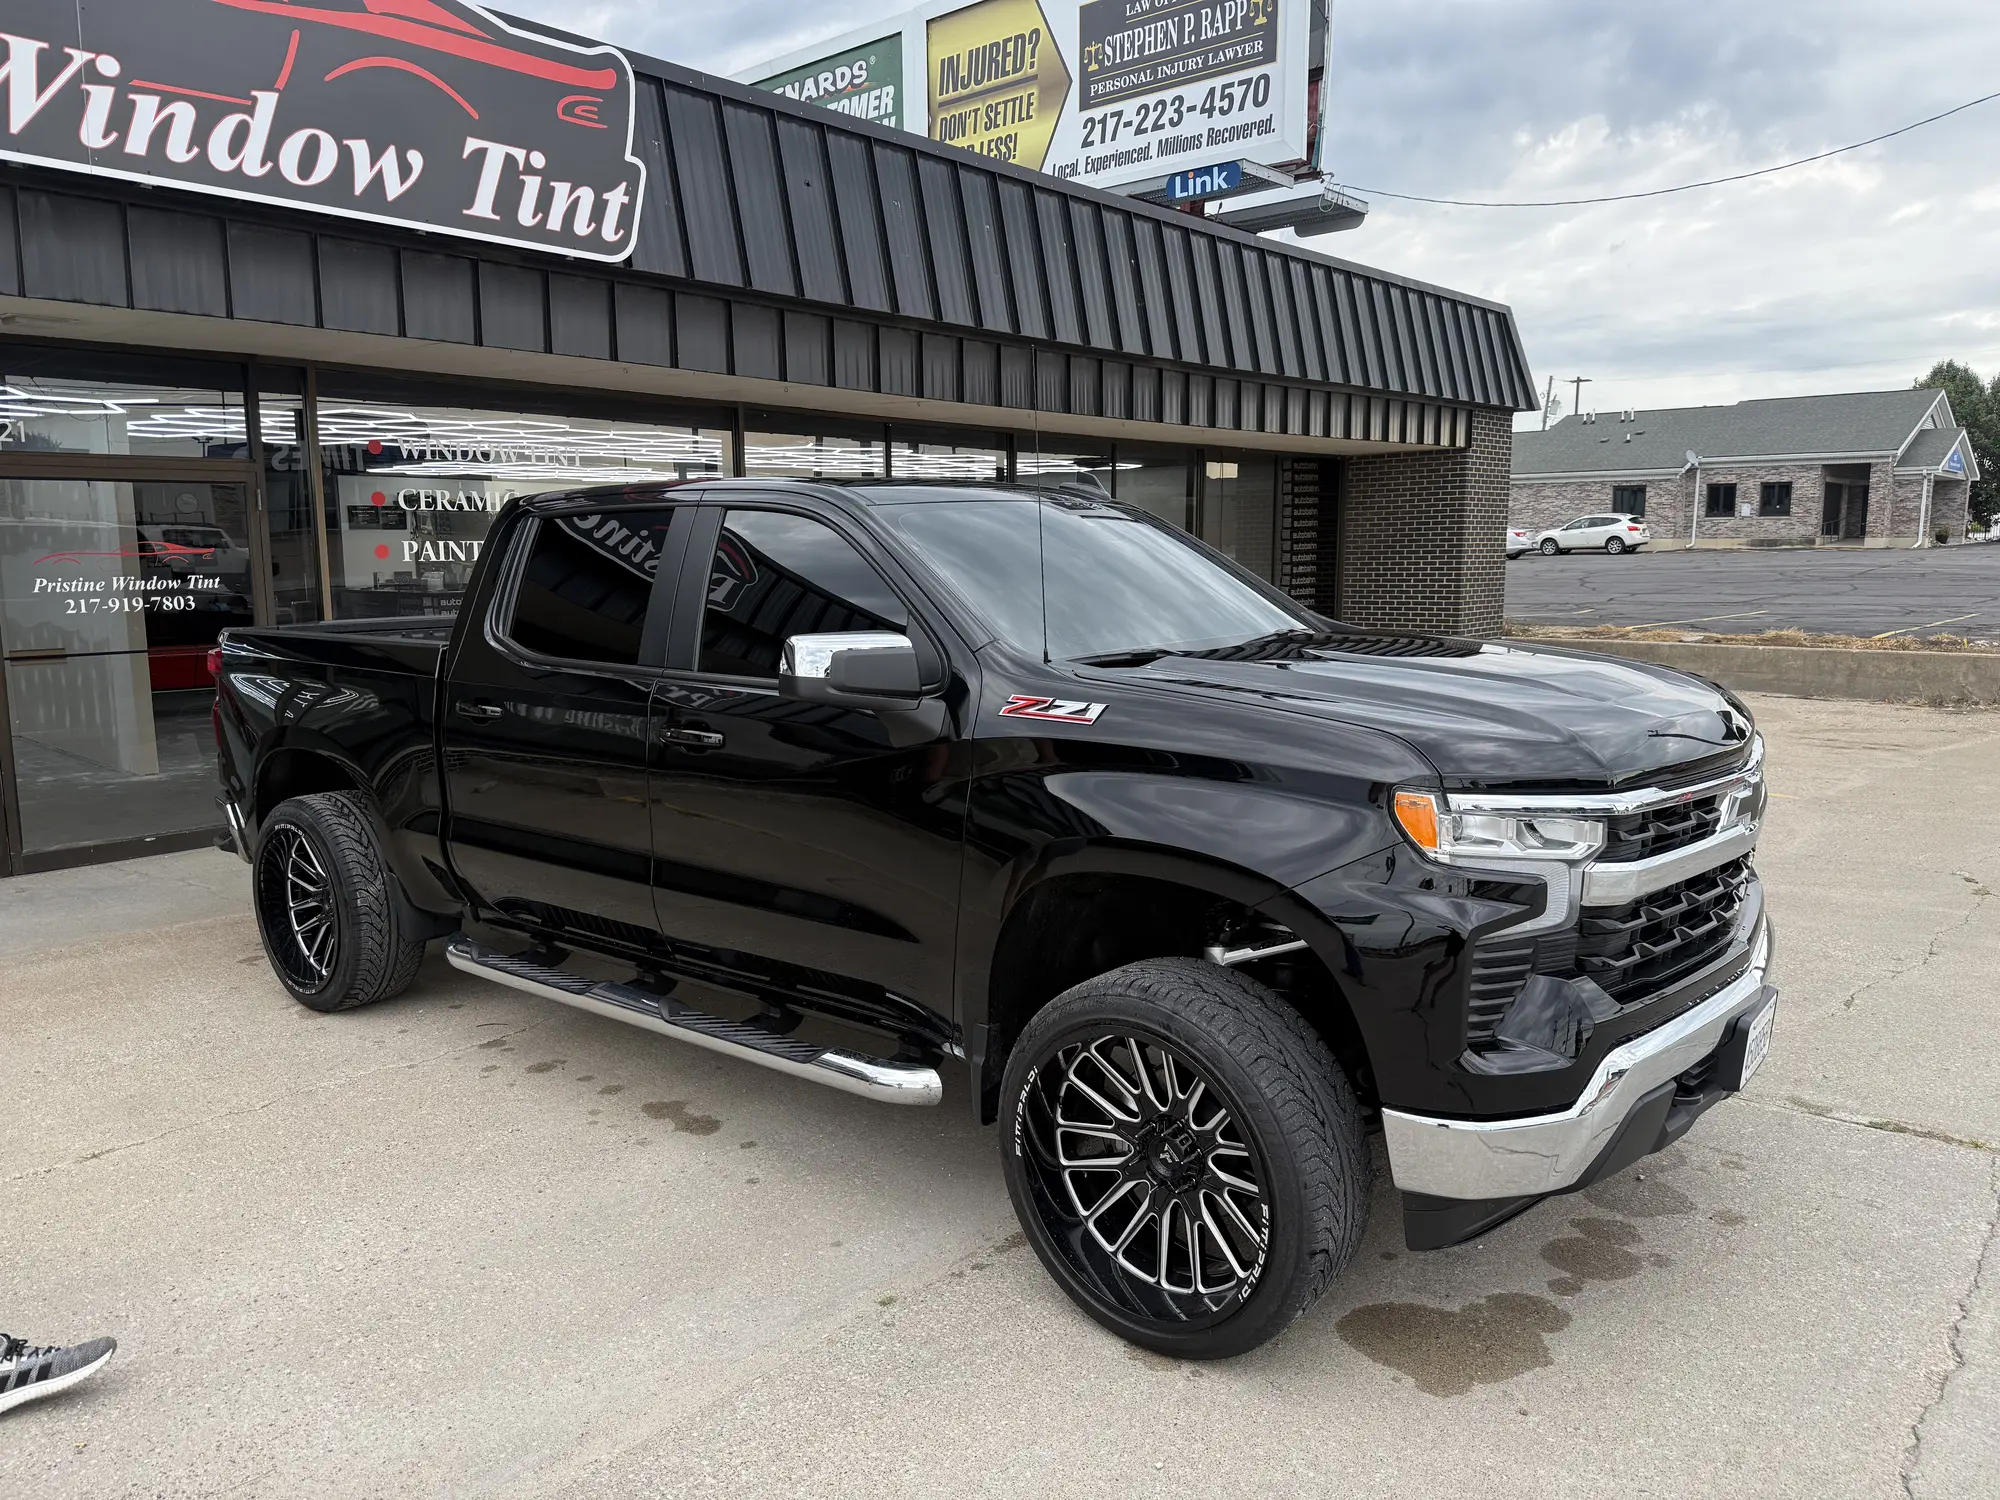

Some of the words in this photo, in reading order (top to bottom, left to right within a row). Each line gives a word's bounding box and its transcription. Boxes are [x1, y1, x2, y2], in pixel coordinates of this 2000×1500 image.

[1126, 1, 1151, 16] LAW
[1105, 16, 1179, 67] STEPHEN
[1183, 13, 1195, 45] P.
[1201, 0, 1247, 40] RAPP
[773, 60, 868, 102] NARDS
[938, 27, 1041, 97] INJURED?
[1090, 71, 1154, 97] PERSONAL
[1157, 57, 1204, 78] INJURY
[1208, 40, 1264, 64] LAWYER
[939, 107, 981, 143] DON'T
[983, 92, 1035, 132] SETTLE
[1081, 73, 1271, 149] 217-223-4570
[0, 31, 424, 202] Window
[461, 135, 630, 243] Tint
[1052, 158, 1081, 179] Local.
[1084, 141, 1153, 175] Experienced.
[1156, 132, 1204, 159] Millions
[1206, 114, 1276, 148] Recovered.
[1174, 165, 1229, 199] Link
[397, 437, 522, 464] WINDOW
[525, 444, 584, 467] TINT
[401, 540, 484, 562] PAINT
[32, 577, 106, 594] Pristine
[111, 575, 182, 592] Window
[186, 574, 221, 590] Tint
[440, 597, 464, 606] auto
[64, 595, 196, 614] 217-919-7803
[998, 694, 1110, 725] Z71
